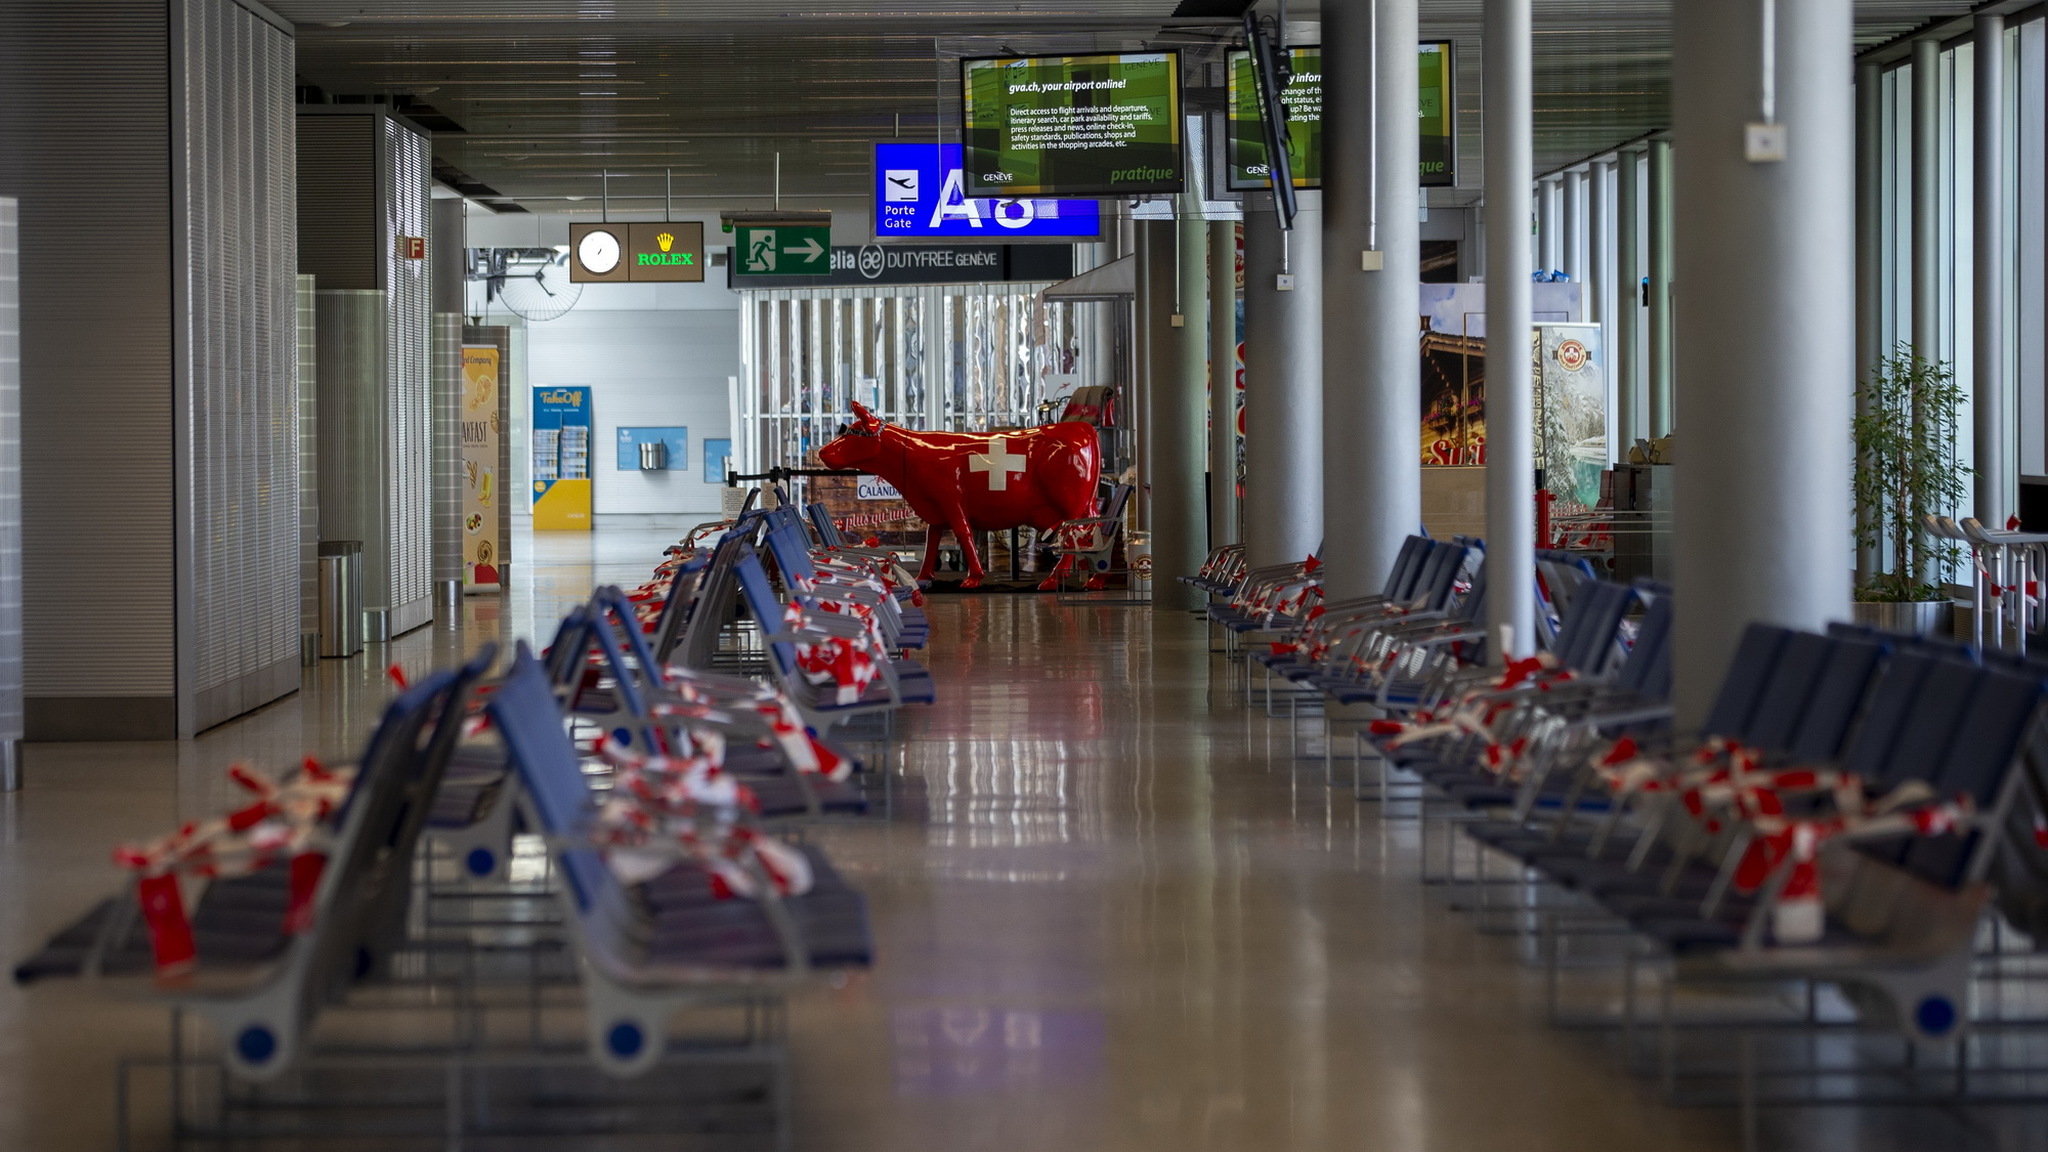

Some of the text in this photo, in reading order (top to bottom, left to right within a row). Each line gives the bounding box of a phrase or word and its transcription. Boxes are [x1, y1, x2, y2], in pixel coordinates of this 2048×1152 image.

[1009, 79, 1126, 94] gva.ch, your airport online!
[1314, 86, 1322, 94] th
[1010, 108, 1029, 116] Direct
[1059, 106, 1075, 116] flight
[1076, 105, 1099, 113] arrivals
[1113, 105, 1149, 113] departures,
[1010, 117, 1036, 125] itinerary
[1037, 115, 1059, 123] search,
[1071, 115, 1085, 124] park
[1085, 114, 1119, 122] availability
[1133, 112, 1153, 120] tariffs,
[1288, 114, 1308, 122] ating
[1011, 126, 1027, 134] press
[1086, 122, 1106, 130] online
[1107, 122, 1135, 130] check-in,
[1011, 130, 1136, 142] safety standards, publications, shops and
[1011, 142, 1038, 150] activities
[1059, 141, 1088, 150] shopping
[1089, 140, 1114, 148] arcades,
[1111, 166, 1174, 184] pratique
[885, 205, 915, 216] Porte
[885, 218, 912, 228] Gate
[412, 240, 421, 256] F
[638, 253, 693, 266] ROLEX
[888, 251, 954, 268] DUTYFREE
[955, 251, 997, 266] GENÈVE
[470, 356, 492, 366] Company
[462, 422, 487, 443] AKFAST
[845, 513, 869, 532] plus
